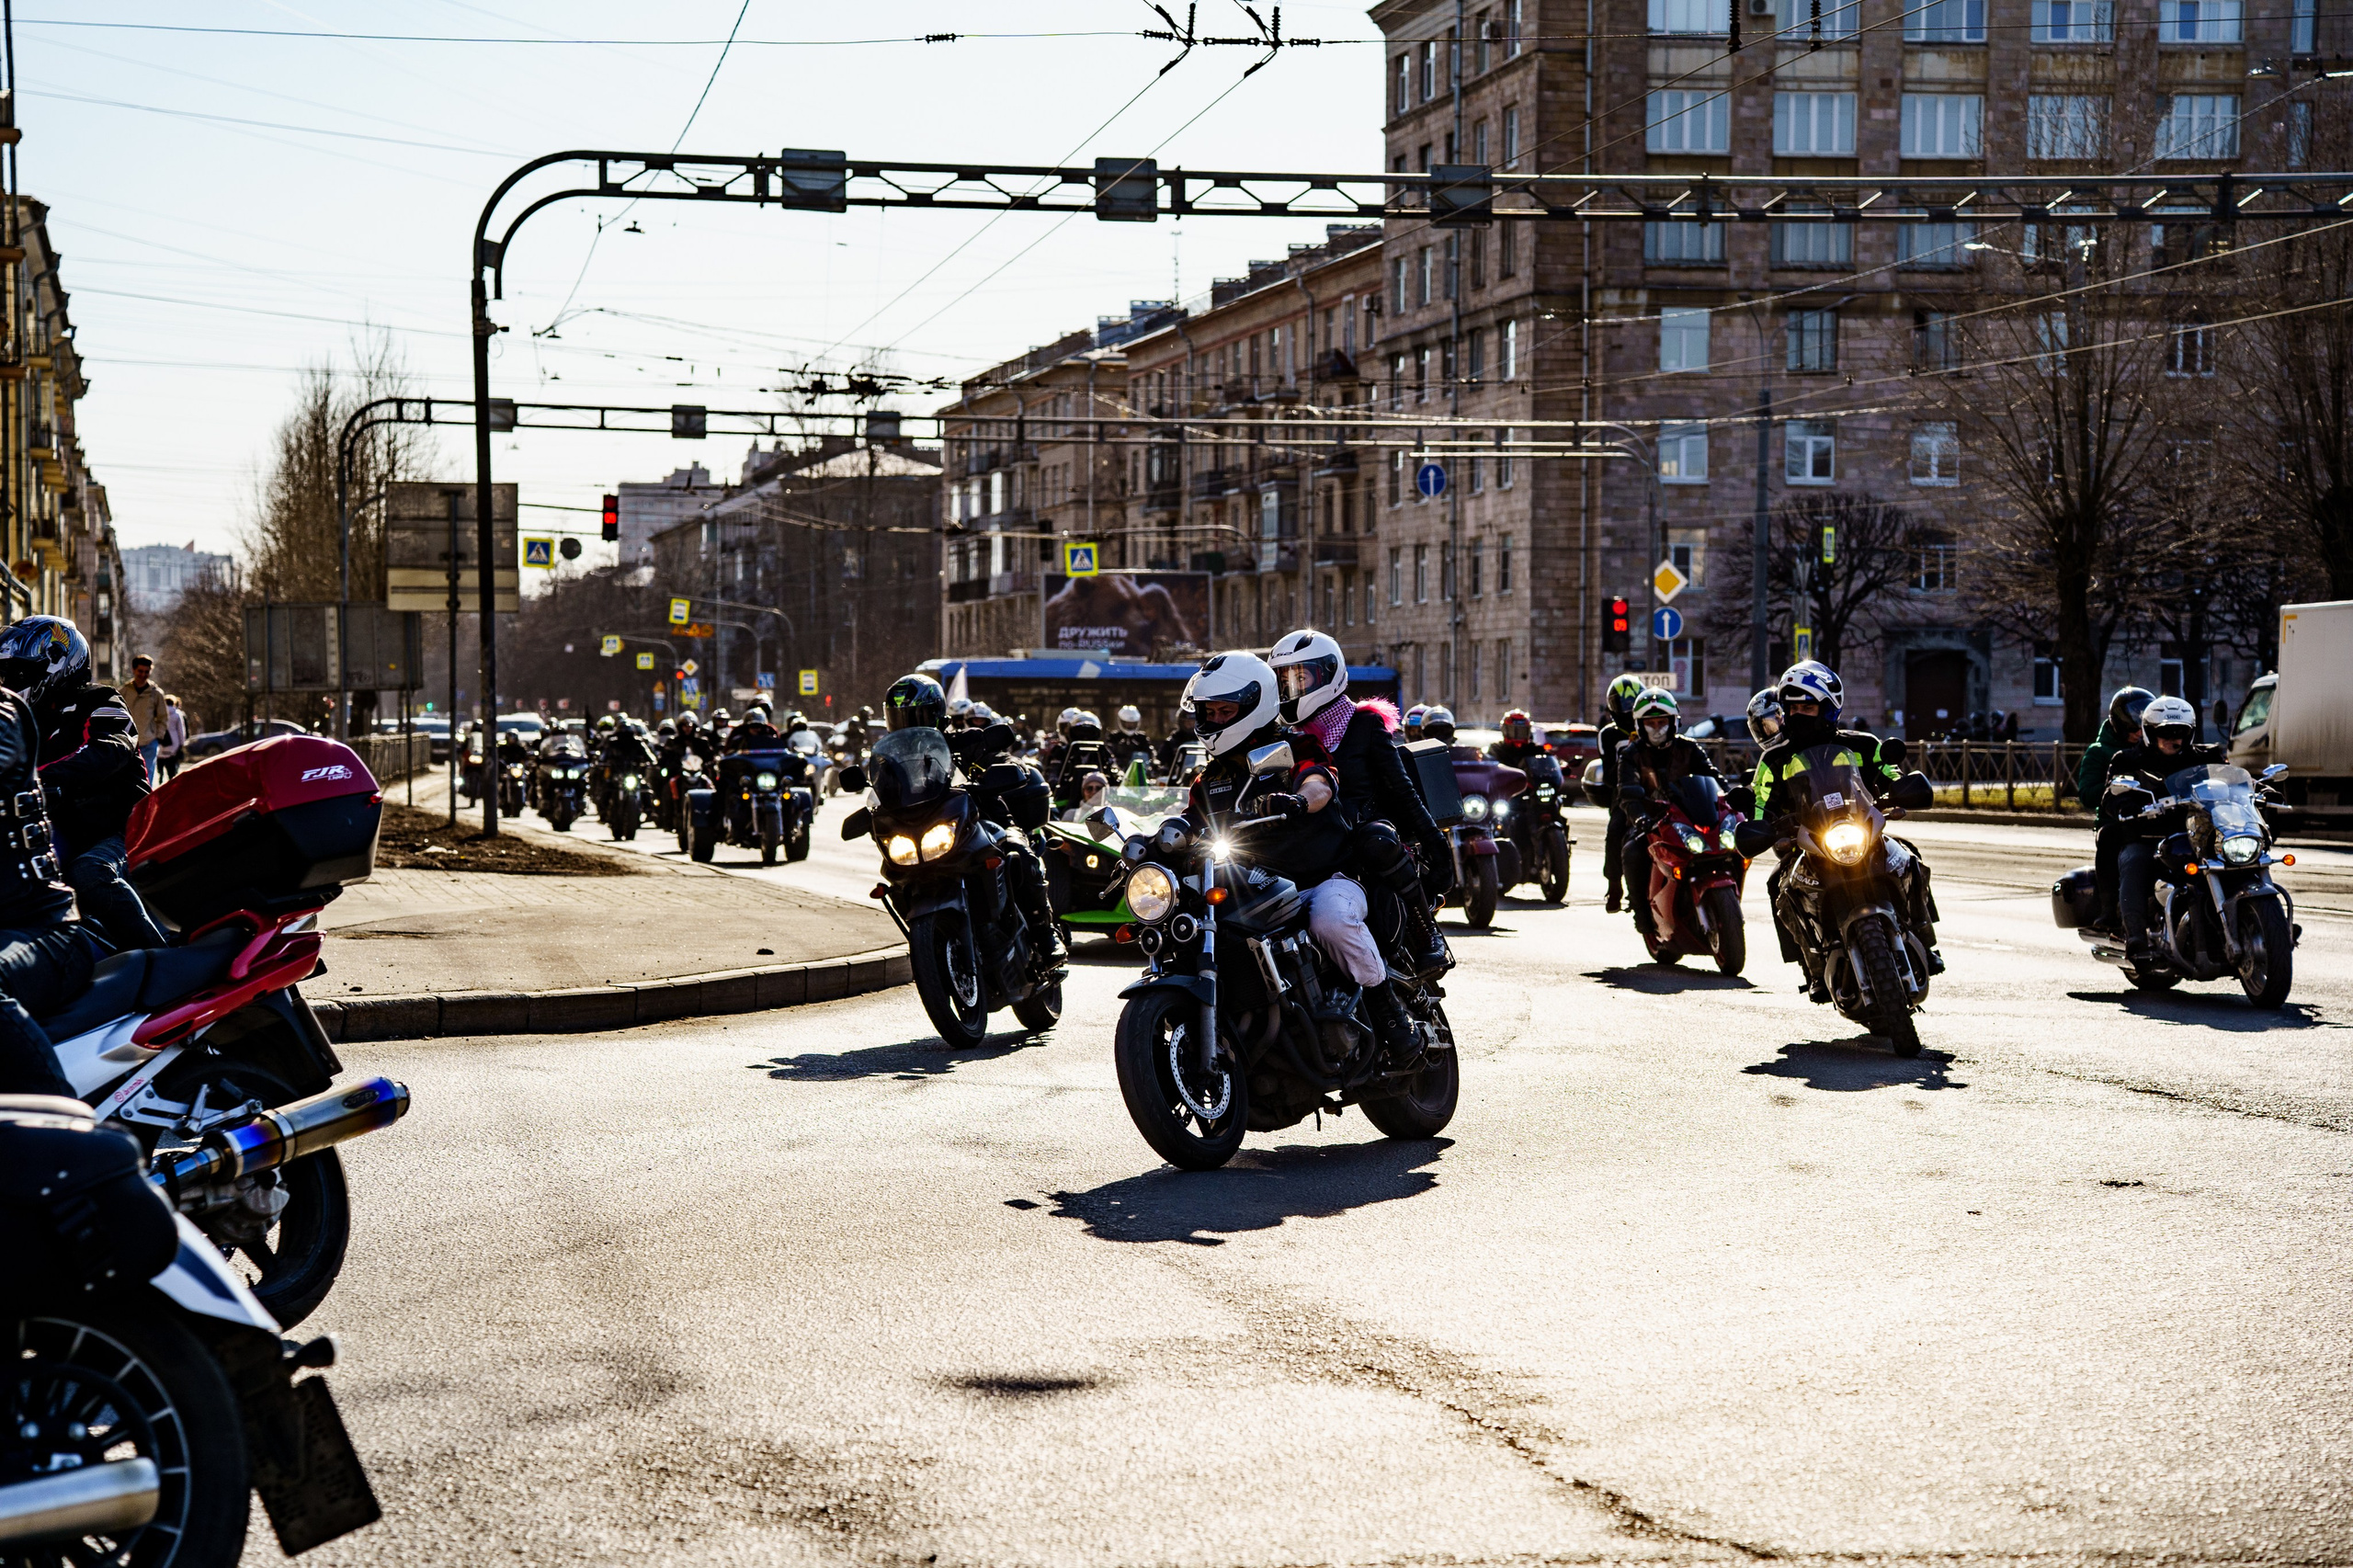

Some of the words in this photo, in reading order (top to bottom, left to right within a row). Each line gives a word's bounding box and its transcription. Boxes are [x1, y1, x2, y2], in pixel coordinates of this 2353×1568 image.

[1058, 626, 1129, 639] ДРУЖИТЬ
[1643, 676, 1670, 687] ТОП
[301, 765, 346, 780] FJR
[1257, 875, 1279, 891] HOND
